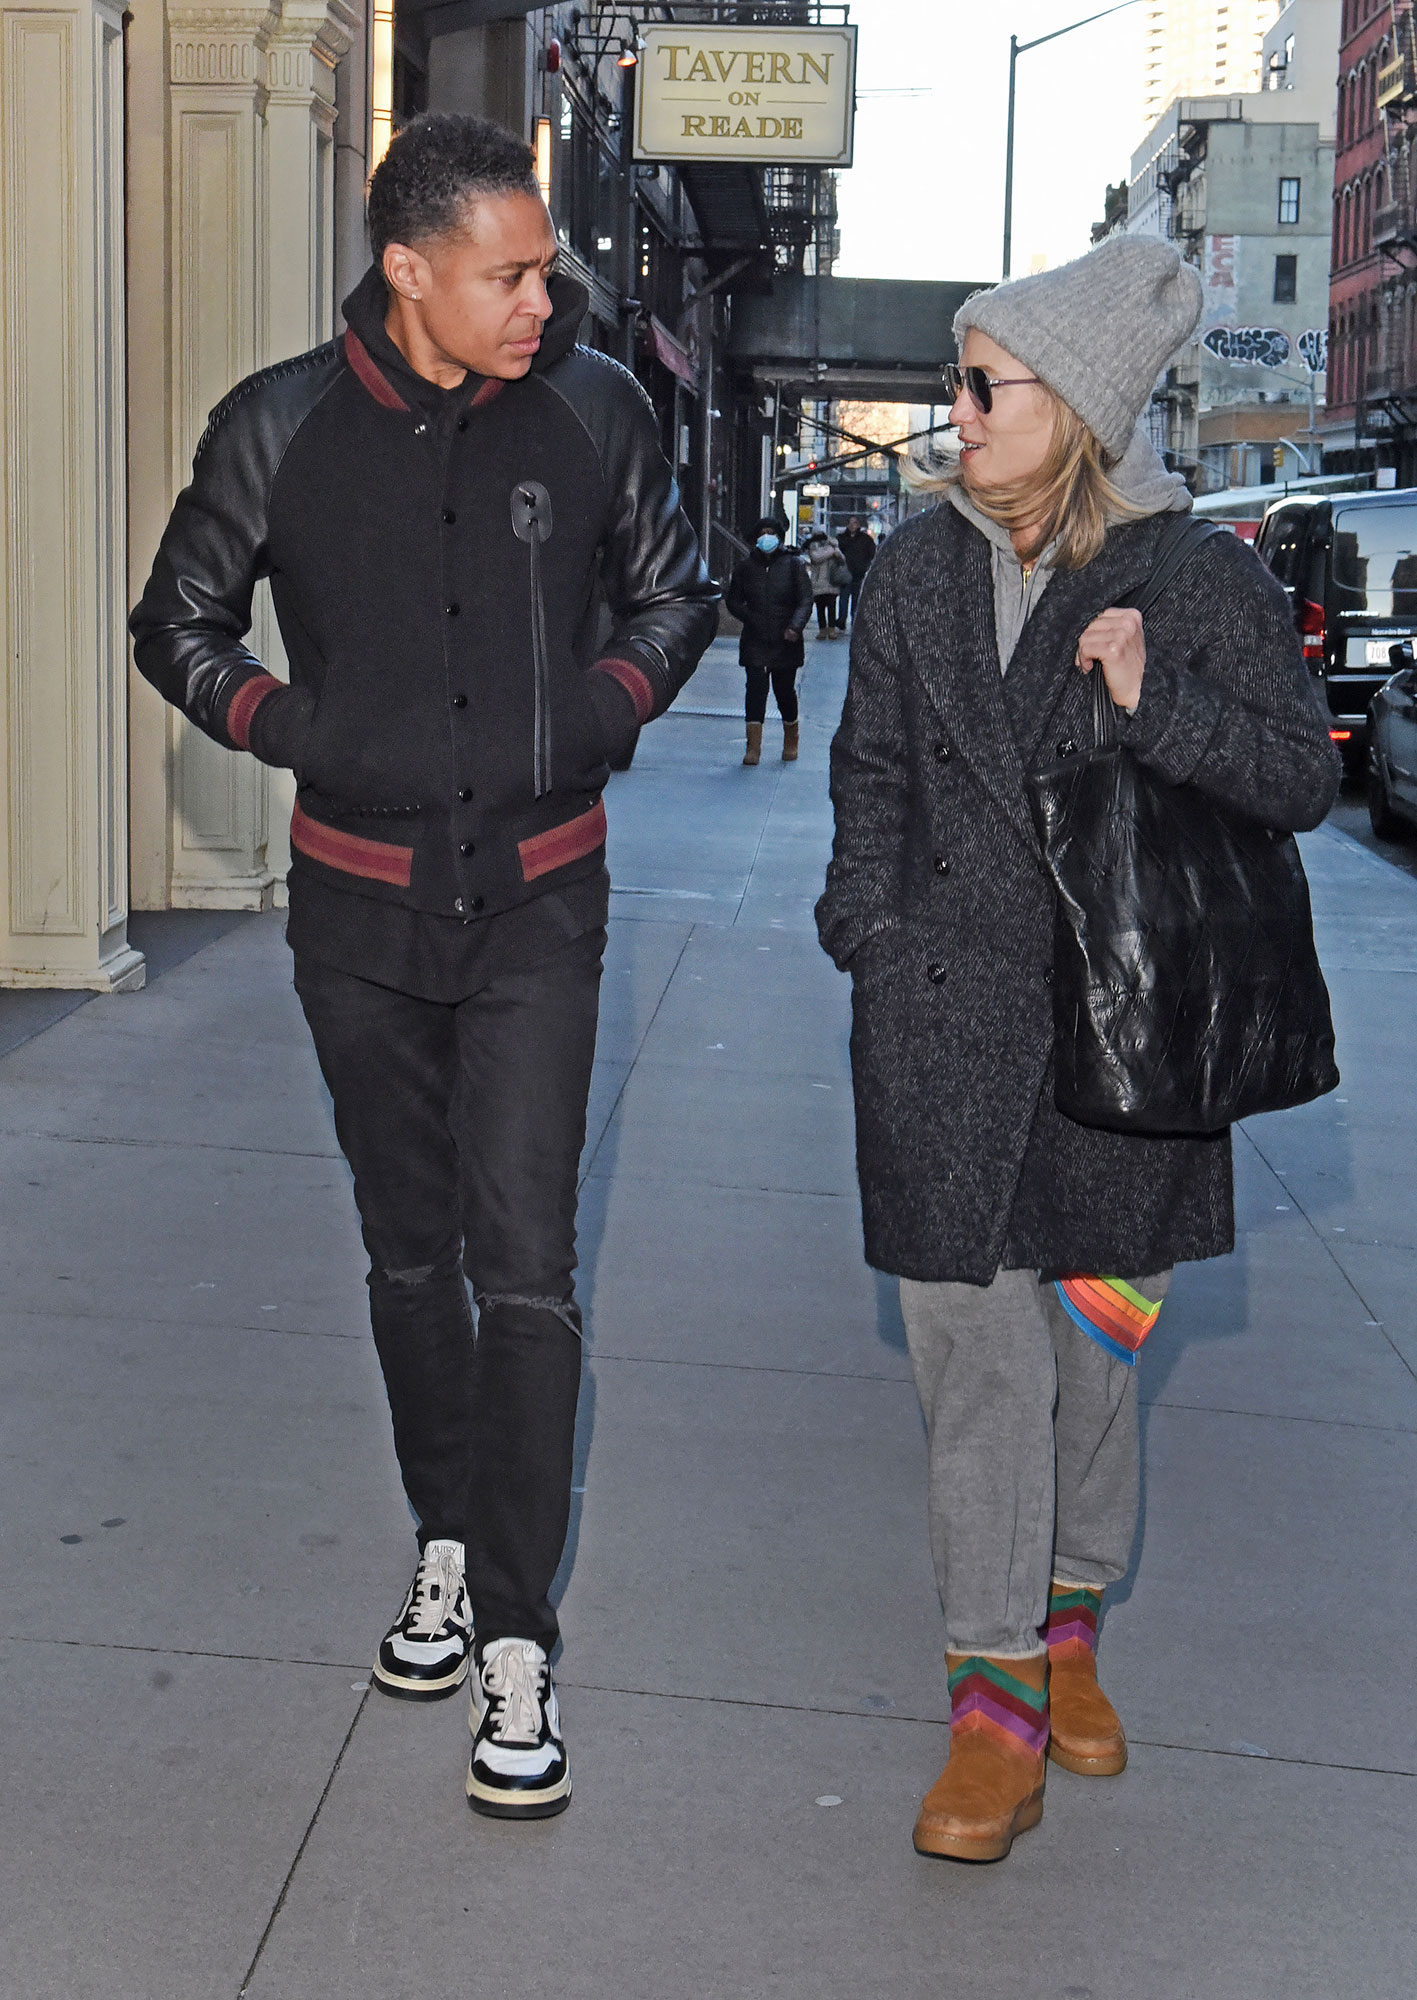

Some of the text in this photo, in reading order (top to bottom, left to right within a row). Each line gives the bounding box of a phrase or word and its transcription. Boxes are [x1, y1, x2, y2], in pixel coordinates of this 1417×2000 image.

[657, 45, 834, 85] TAVERN
[728, 92, 761, 106] ON
[681, 115, 803, 139] READE
